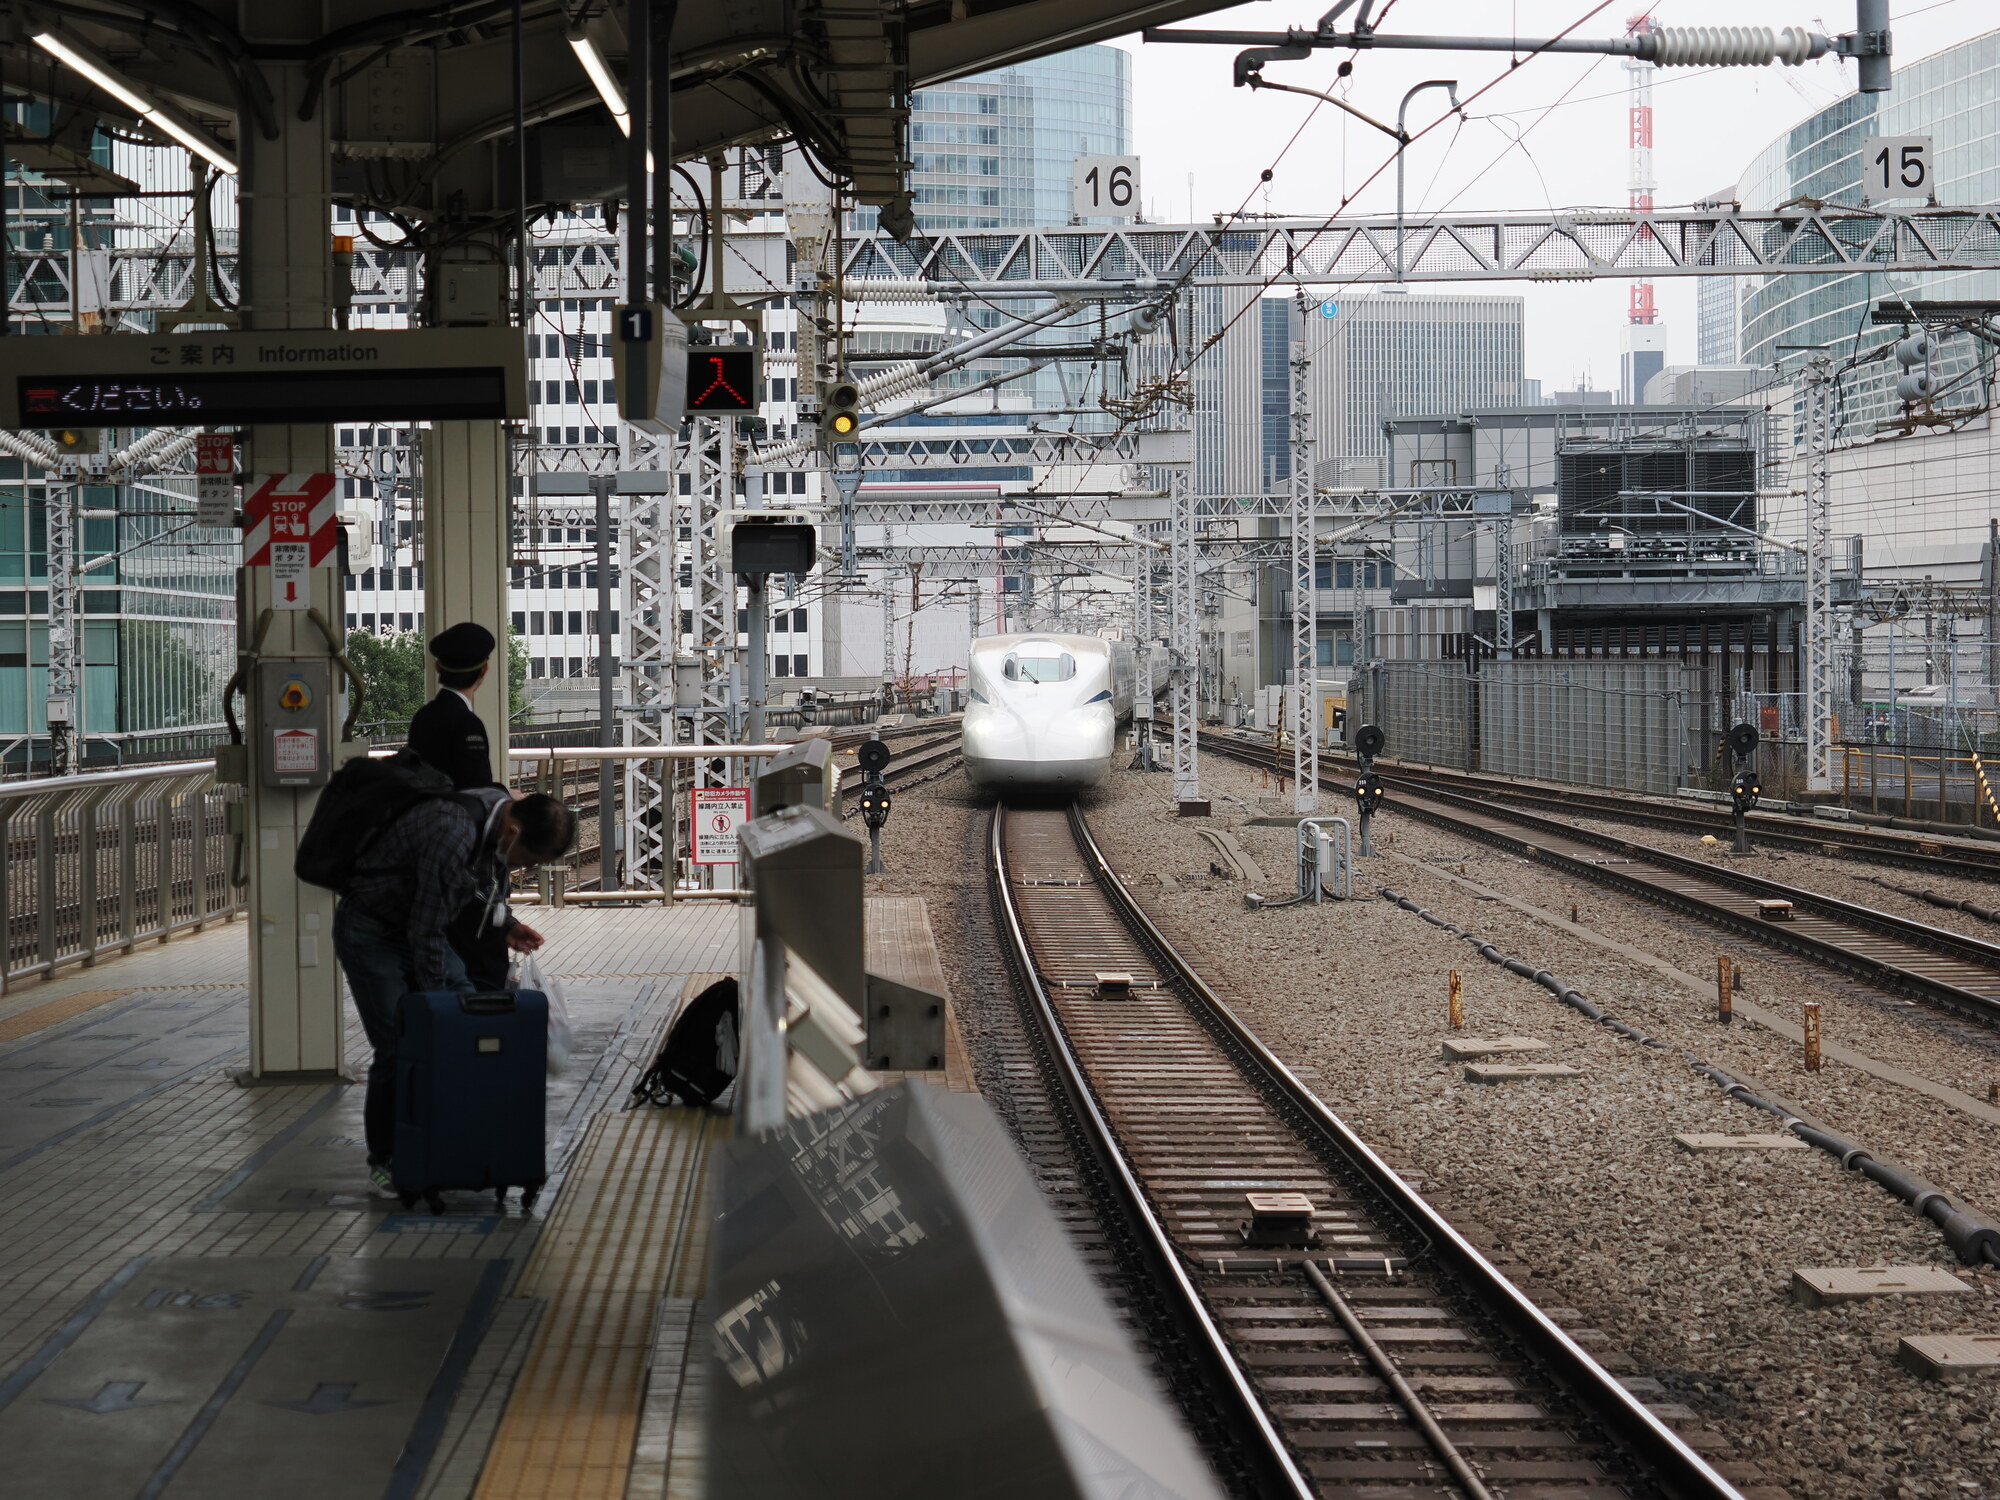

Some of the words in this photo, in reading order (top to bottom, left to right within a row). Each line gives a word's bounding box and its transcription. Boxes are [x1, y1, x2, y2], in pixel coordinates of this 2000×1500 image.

[1876, 146, 1924, 188] 15
[1085, 166, 1132, 207] 16
[628, 313, 640, 338] 1
[150, 344, 235, 365] ご案内
[258, 344, 379, 363] Information
[198, 436, 230, 448] STOP
[272, 502, 306, 512] STOP
[274, 545, 305, 553] 非常停止
[275, 554, 304, 562] ボタン
